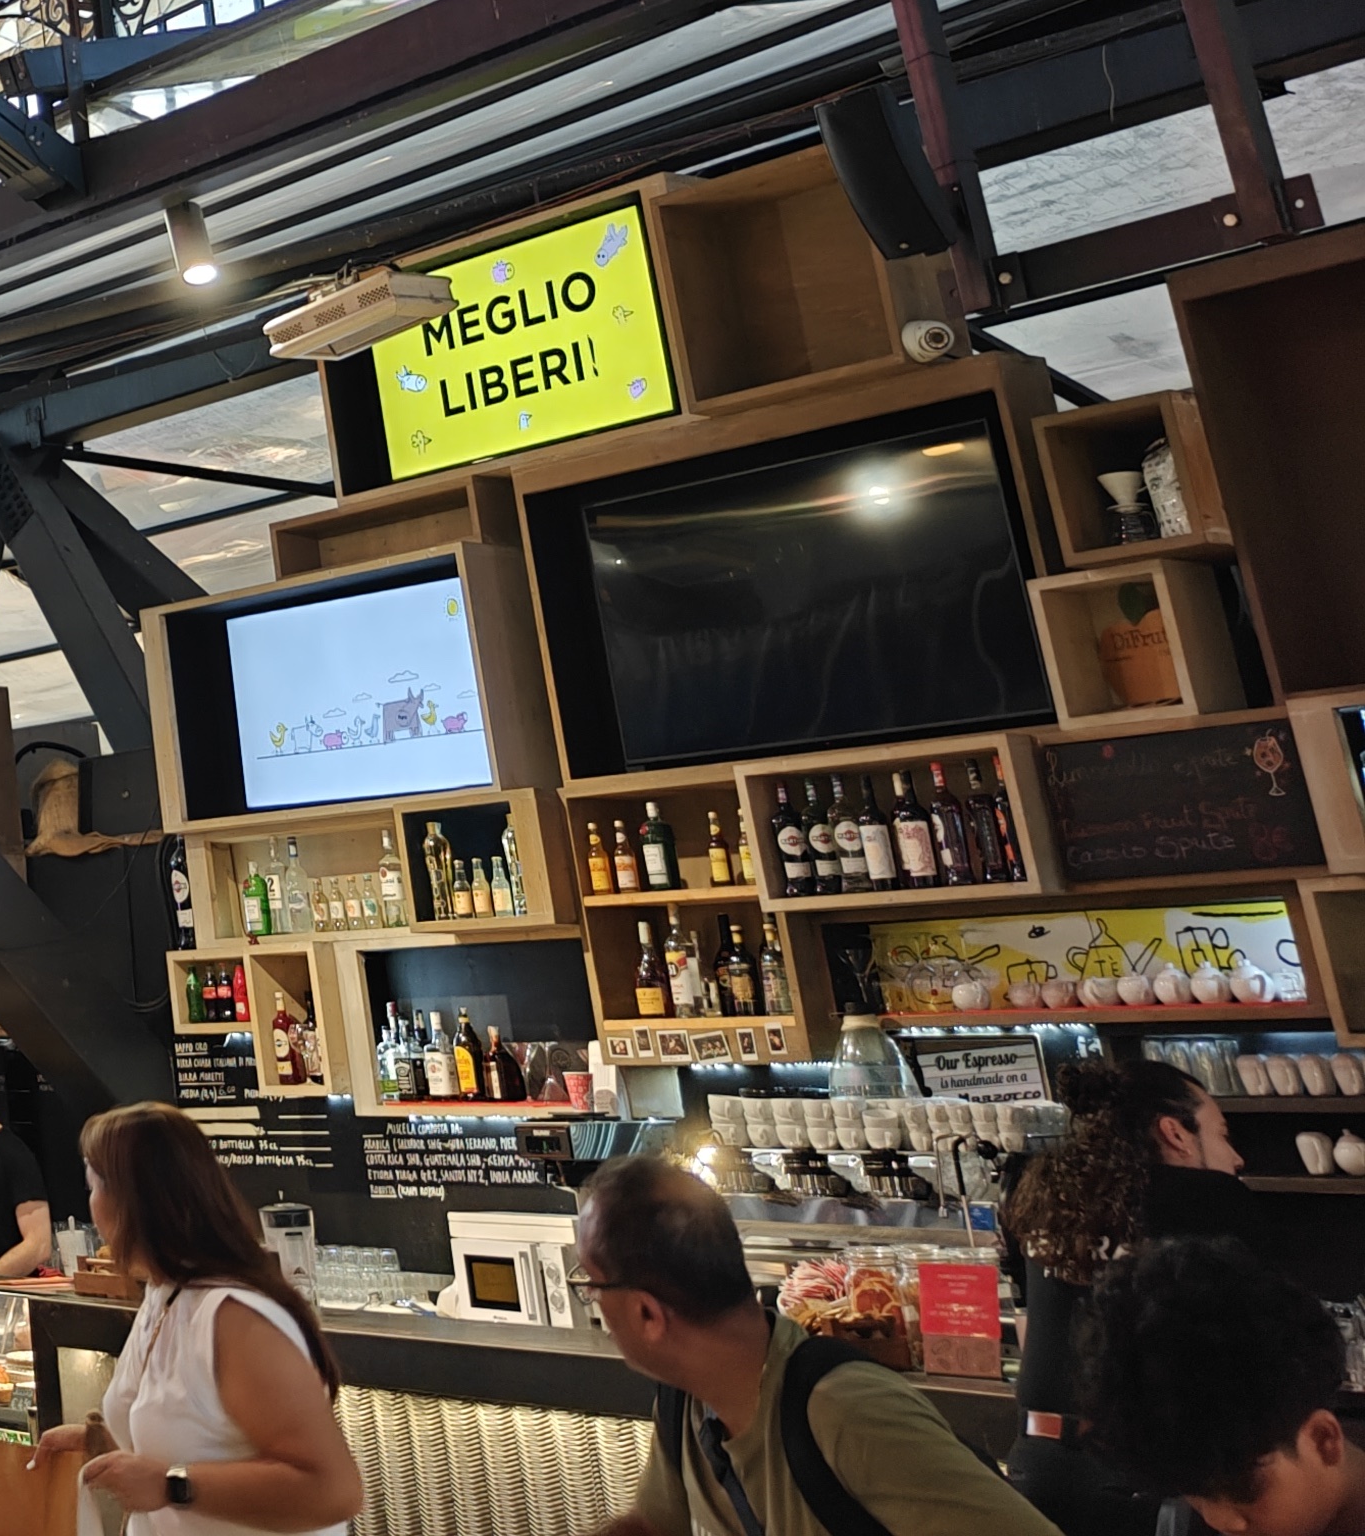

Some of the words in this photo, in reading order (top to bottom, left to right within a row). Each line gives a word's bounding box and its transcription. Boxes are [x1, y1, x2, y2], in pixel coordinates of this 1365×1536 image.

[422, 271, 596, 356] MEGLIO
[439, 334, 599, 417] LIBERI!
[935, 1054, 960, 1071] Our
[962, 1052, 1018, 1073] Espresso
[940, 1077, 949, 1089] is
[950, 1072, 1004, 1088] handmade
[1006, 1073, 1018, 1084] on
[1021, 1072, 1027, 1082] a
[219, 1140, 255, 1150] BOTTIGLIA
[364, 1139, 391, 1150] ARABICA
[255, 1154, 295, 1166] BOTTIGLIA
